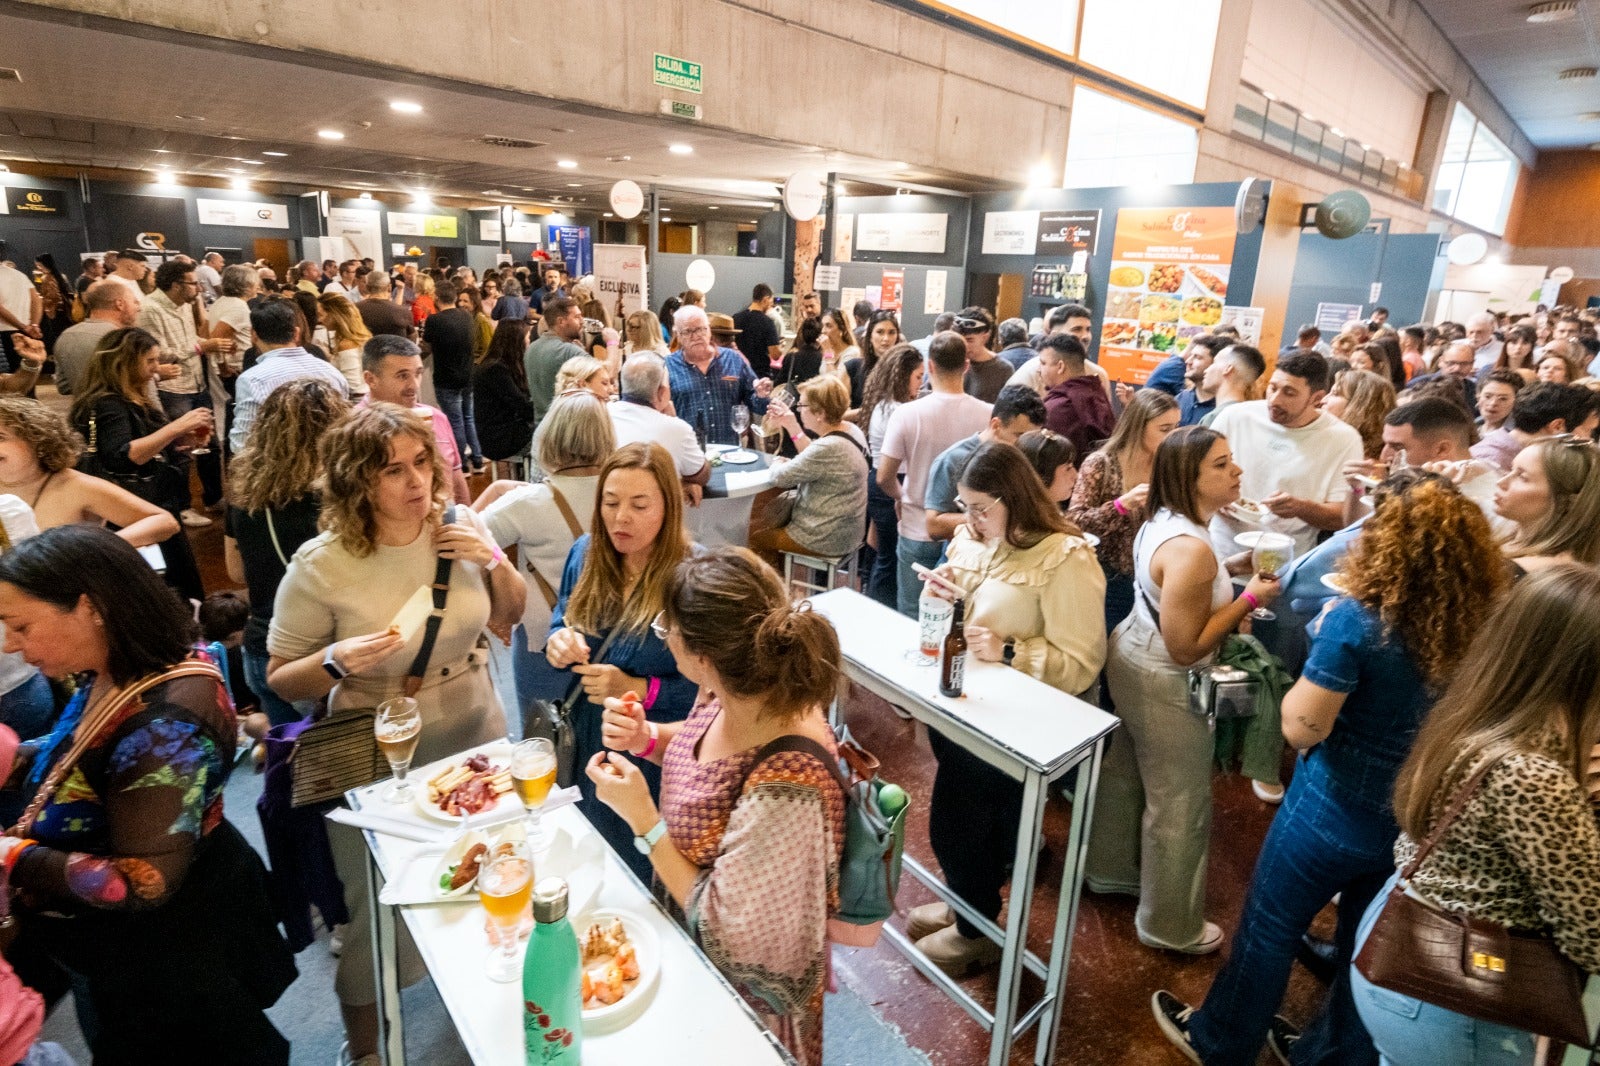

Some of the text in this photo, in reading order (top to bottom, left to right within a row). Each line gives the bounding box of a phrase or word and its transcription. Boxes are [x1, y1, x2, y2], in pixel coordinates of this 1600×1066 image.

[657, 57, 699, 77] SALIDA DE
[656, 70, 700, 89] EMERGENCIA
[600, 280, 640, 294] EXCLUSIVA
